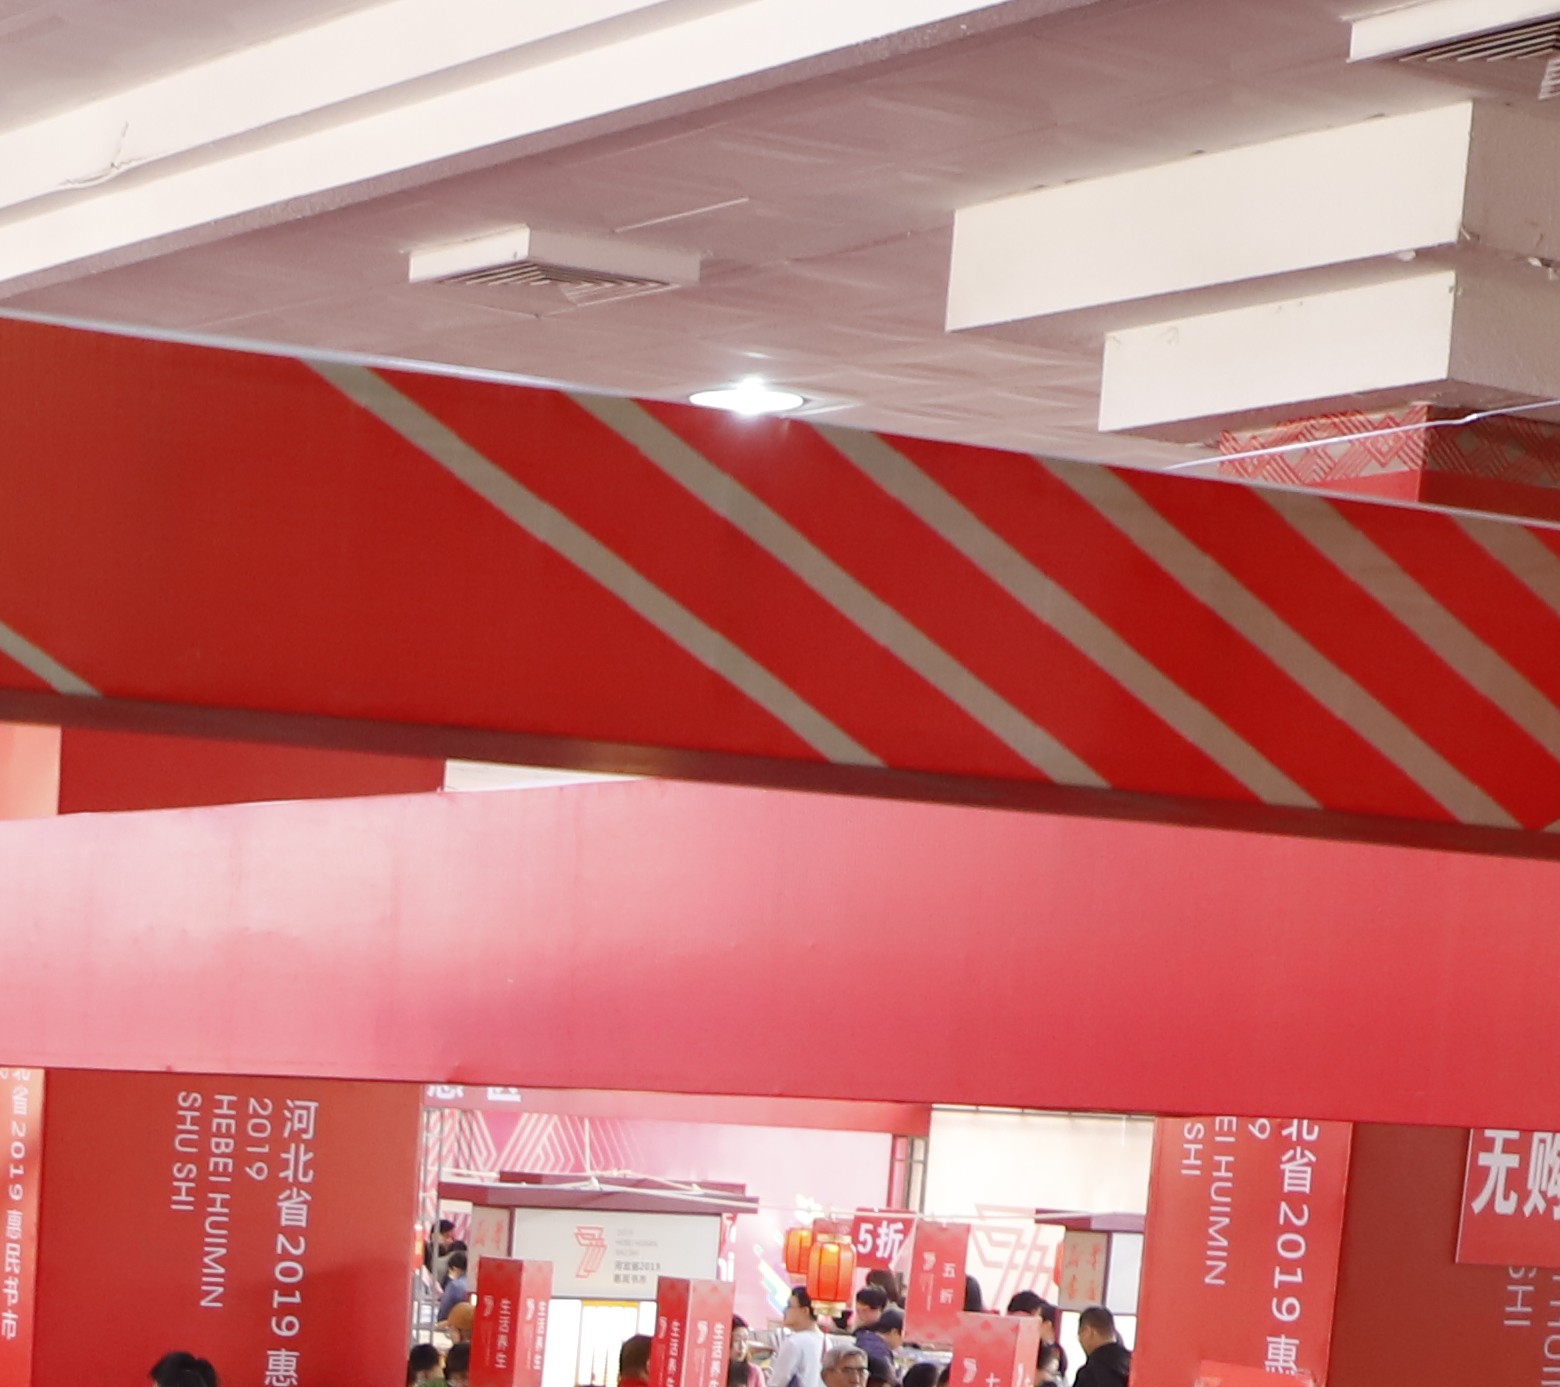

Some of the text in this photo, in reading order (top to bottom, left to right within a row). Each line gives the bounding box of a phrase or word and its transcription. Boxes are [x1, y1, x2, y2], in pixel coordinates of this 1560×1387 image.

[170, 1091, 202, 1211] SHU SHI
[245, 1097, 273, 1182] 2019
[1182, 1121, 1205, 1176] SHI
[199, 1094, 238, 1308] HEBEI HUIMIN
[857, 1220, 905, 1259] 5折
[1204, 1155, 1235, 1286] HUIMIN
